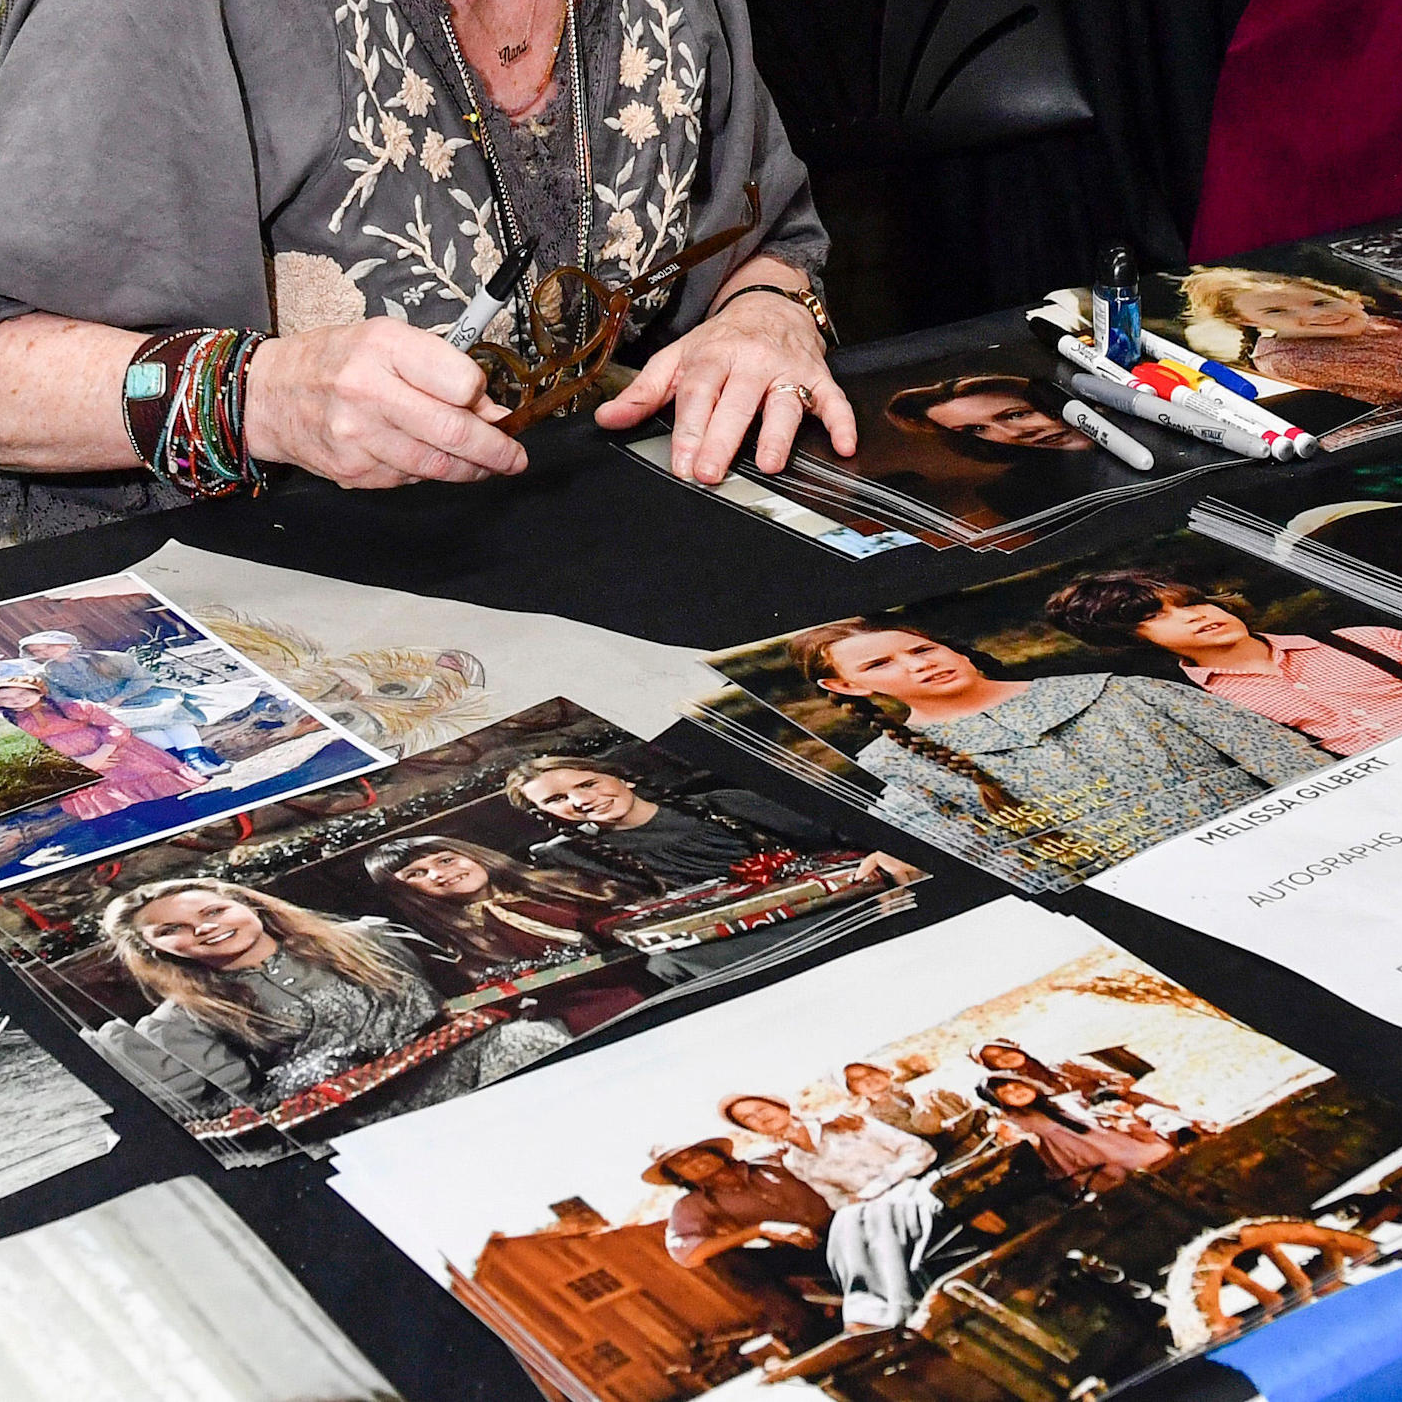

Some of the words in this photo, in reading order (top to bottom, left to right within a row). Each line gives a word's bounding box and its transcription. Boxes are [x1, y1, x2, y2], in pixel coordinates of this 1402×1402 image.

[969, 801, 1037, 832] Little
[1032, 776, 1112, 815] House
[1026, 793, 1114, 830] Prairie
[1194, 797, 1299, 846] MELISSA
[1295, 755, 1391, 804] GILBERT
[1018, 833, 1083, 865] Little
[1076, 805, 1151, 843] House
